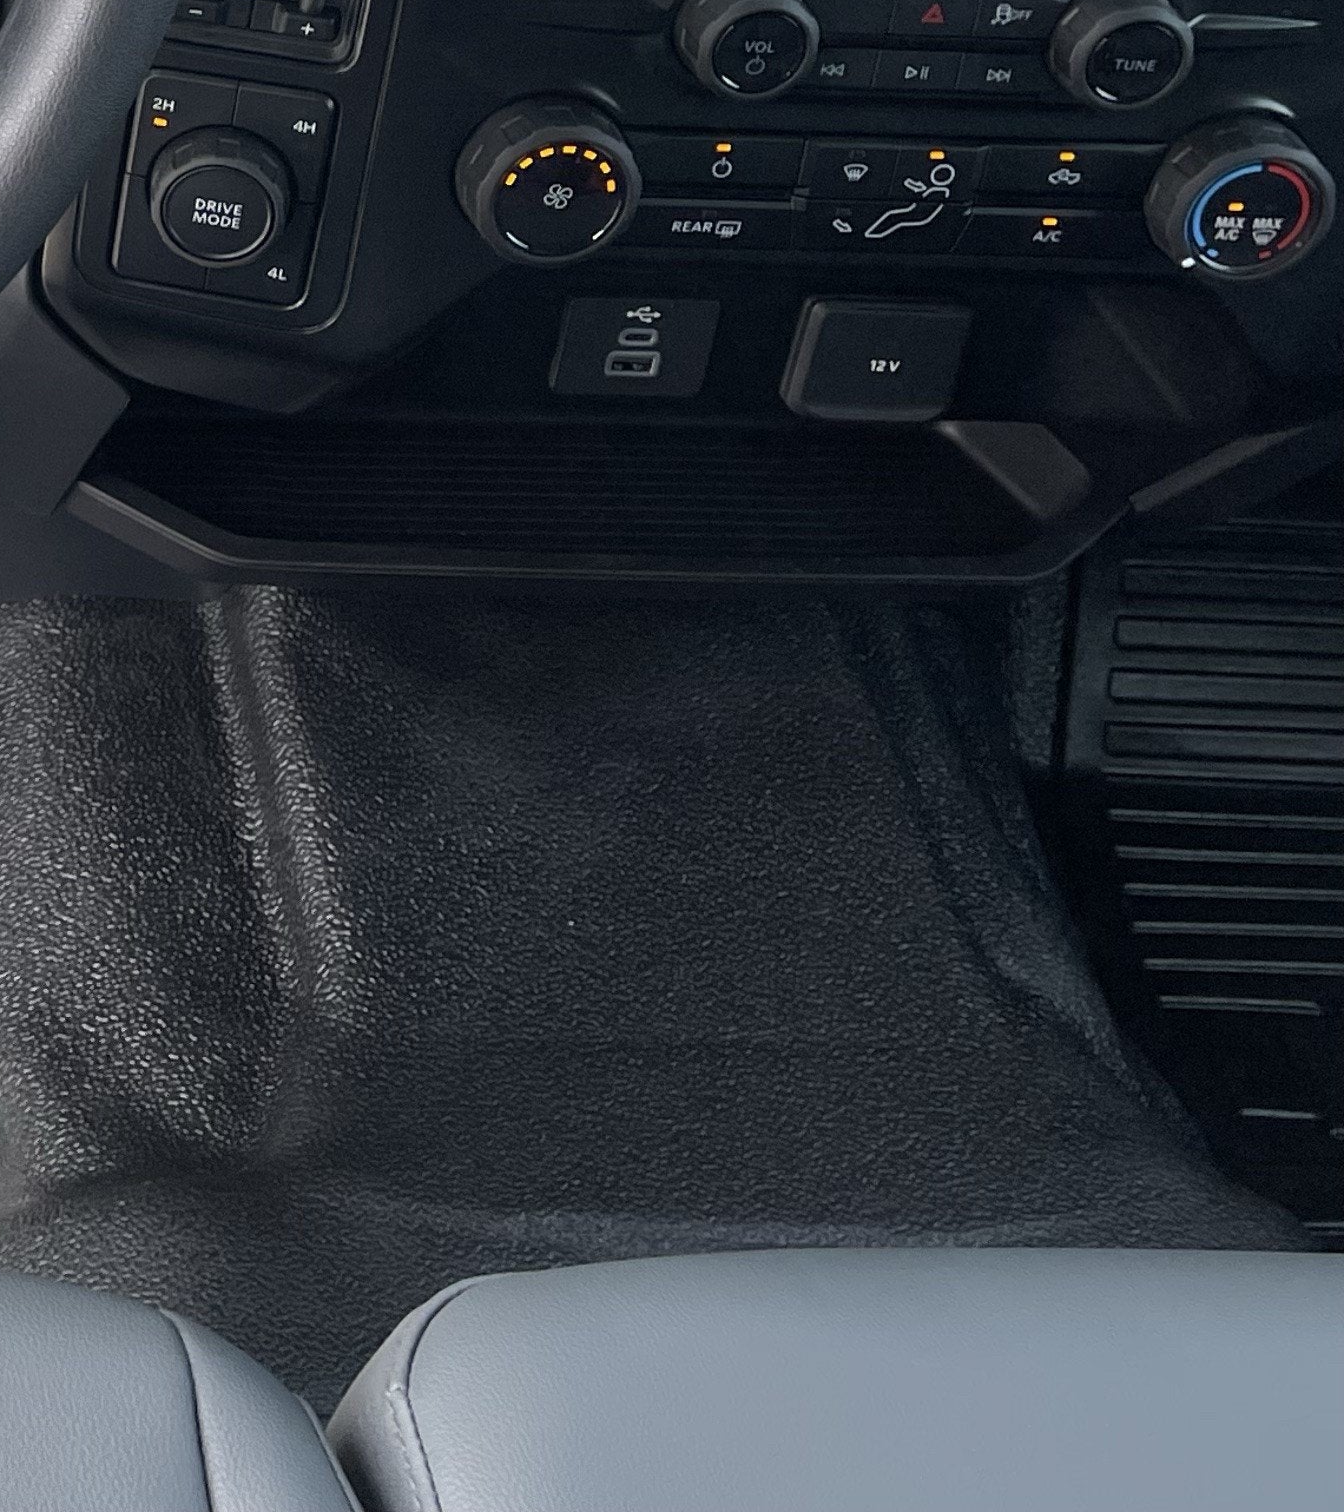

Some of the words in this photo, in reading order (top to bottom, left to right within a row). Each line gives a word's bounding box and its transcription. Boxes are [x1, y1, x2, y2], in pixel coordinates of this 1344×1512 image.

[745, 40, 774, 54] VOL
[1115, 58, 1158, 73] TUNE
[152, 97, 175, 113] 2H
[293, 120, 316, 135] 4H
[194, 198, 243, 217] DRIVE
[192, 212, 241, 230] MODE
[672, 221, 712, 234] REAR
[1215, 217, 1244, 228] MAX
[1252, 217, 1283, 229] MAX
[1033, 230, 1062, 243] A/C
[1215, 229, 1240, 241] A/C
[267, 267, 287, 282] 4L
